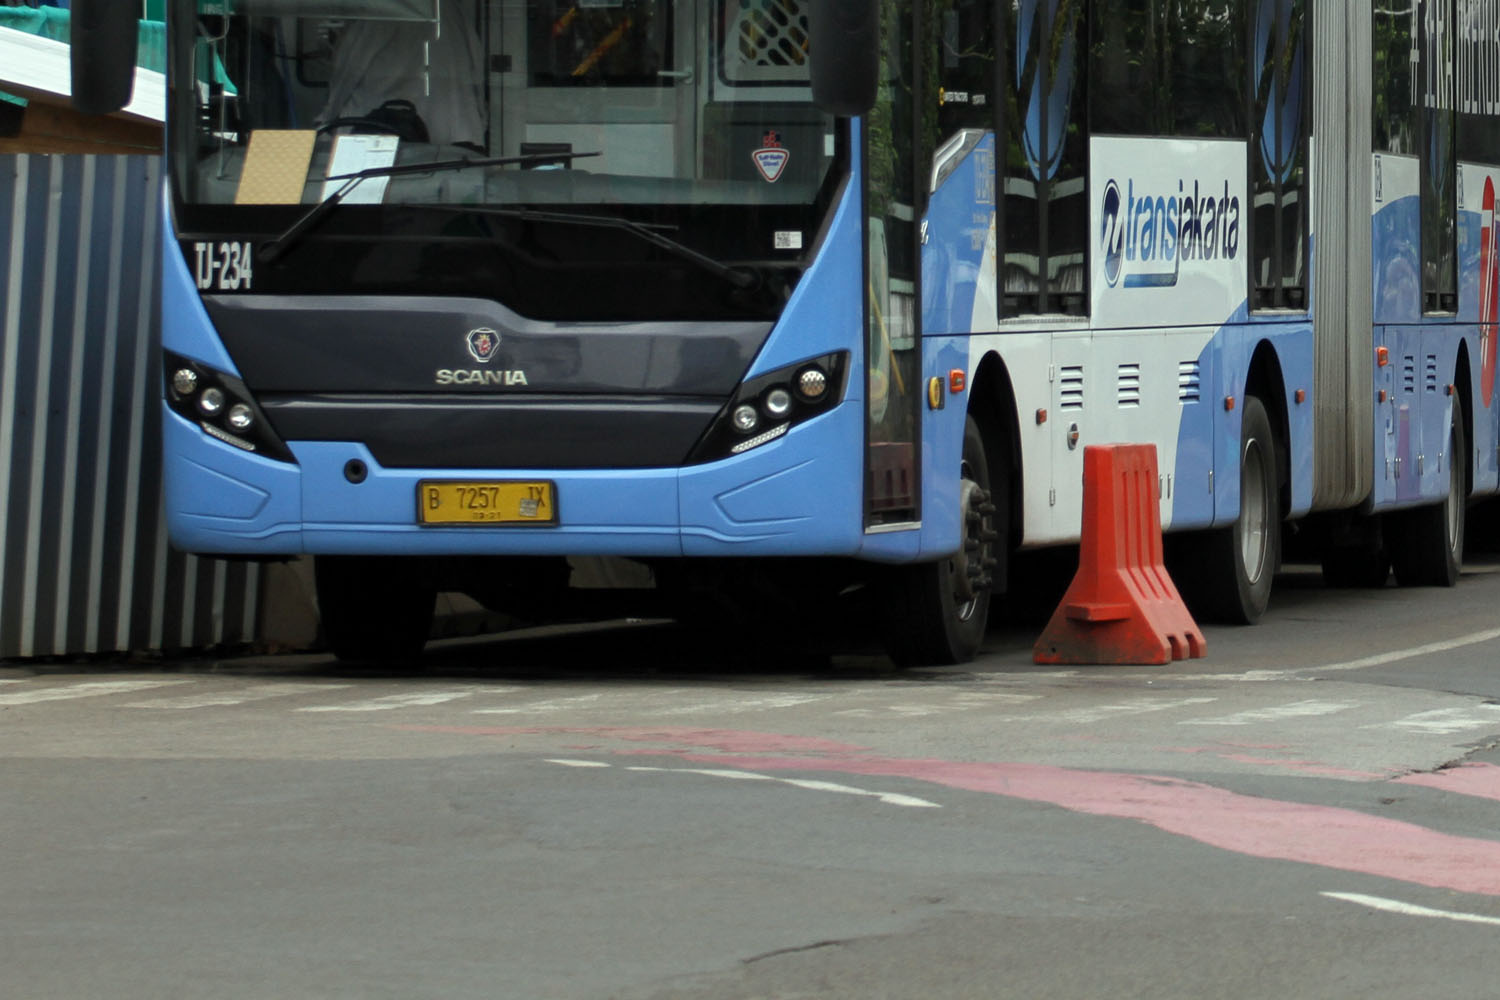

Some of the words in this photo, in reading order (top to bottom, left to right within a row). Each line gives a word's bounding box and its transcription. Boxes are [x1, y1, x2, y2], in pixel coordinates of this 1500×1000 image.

[1124, 178, 1240, 288] transjakarta
[195, 242, 252, 289] TJ-234
[435, 369, 528, 386] SCANIA
[428, 488, 441, 510] B
[456, 486, 500, 510] 7257
